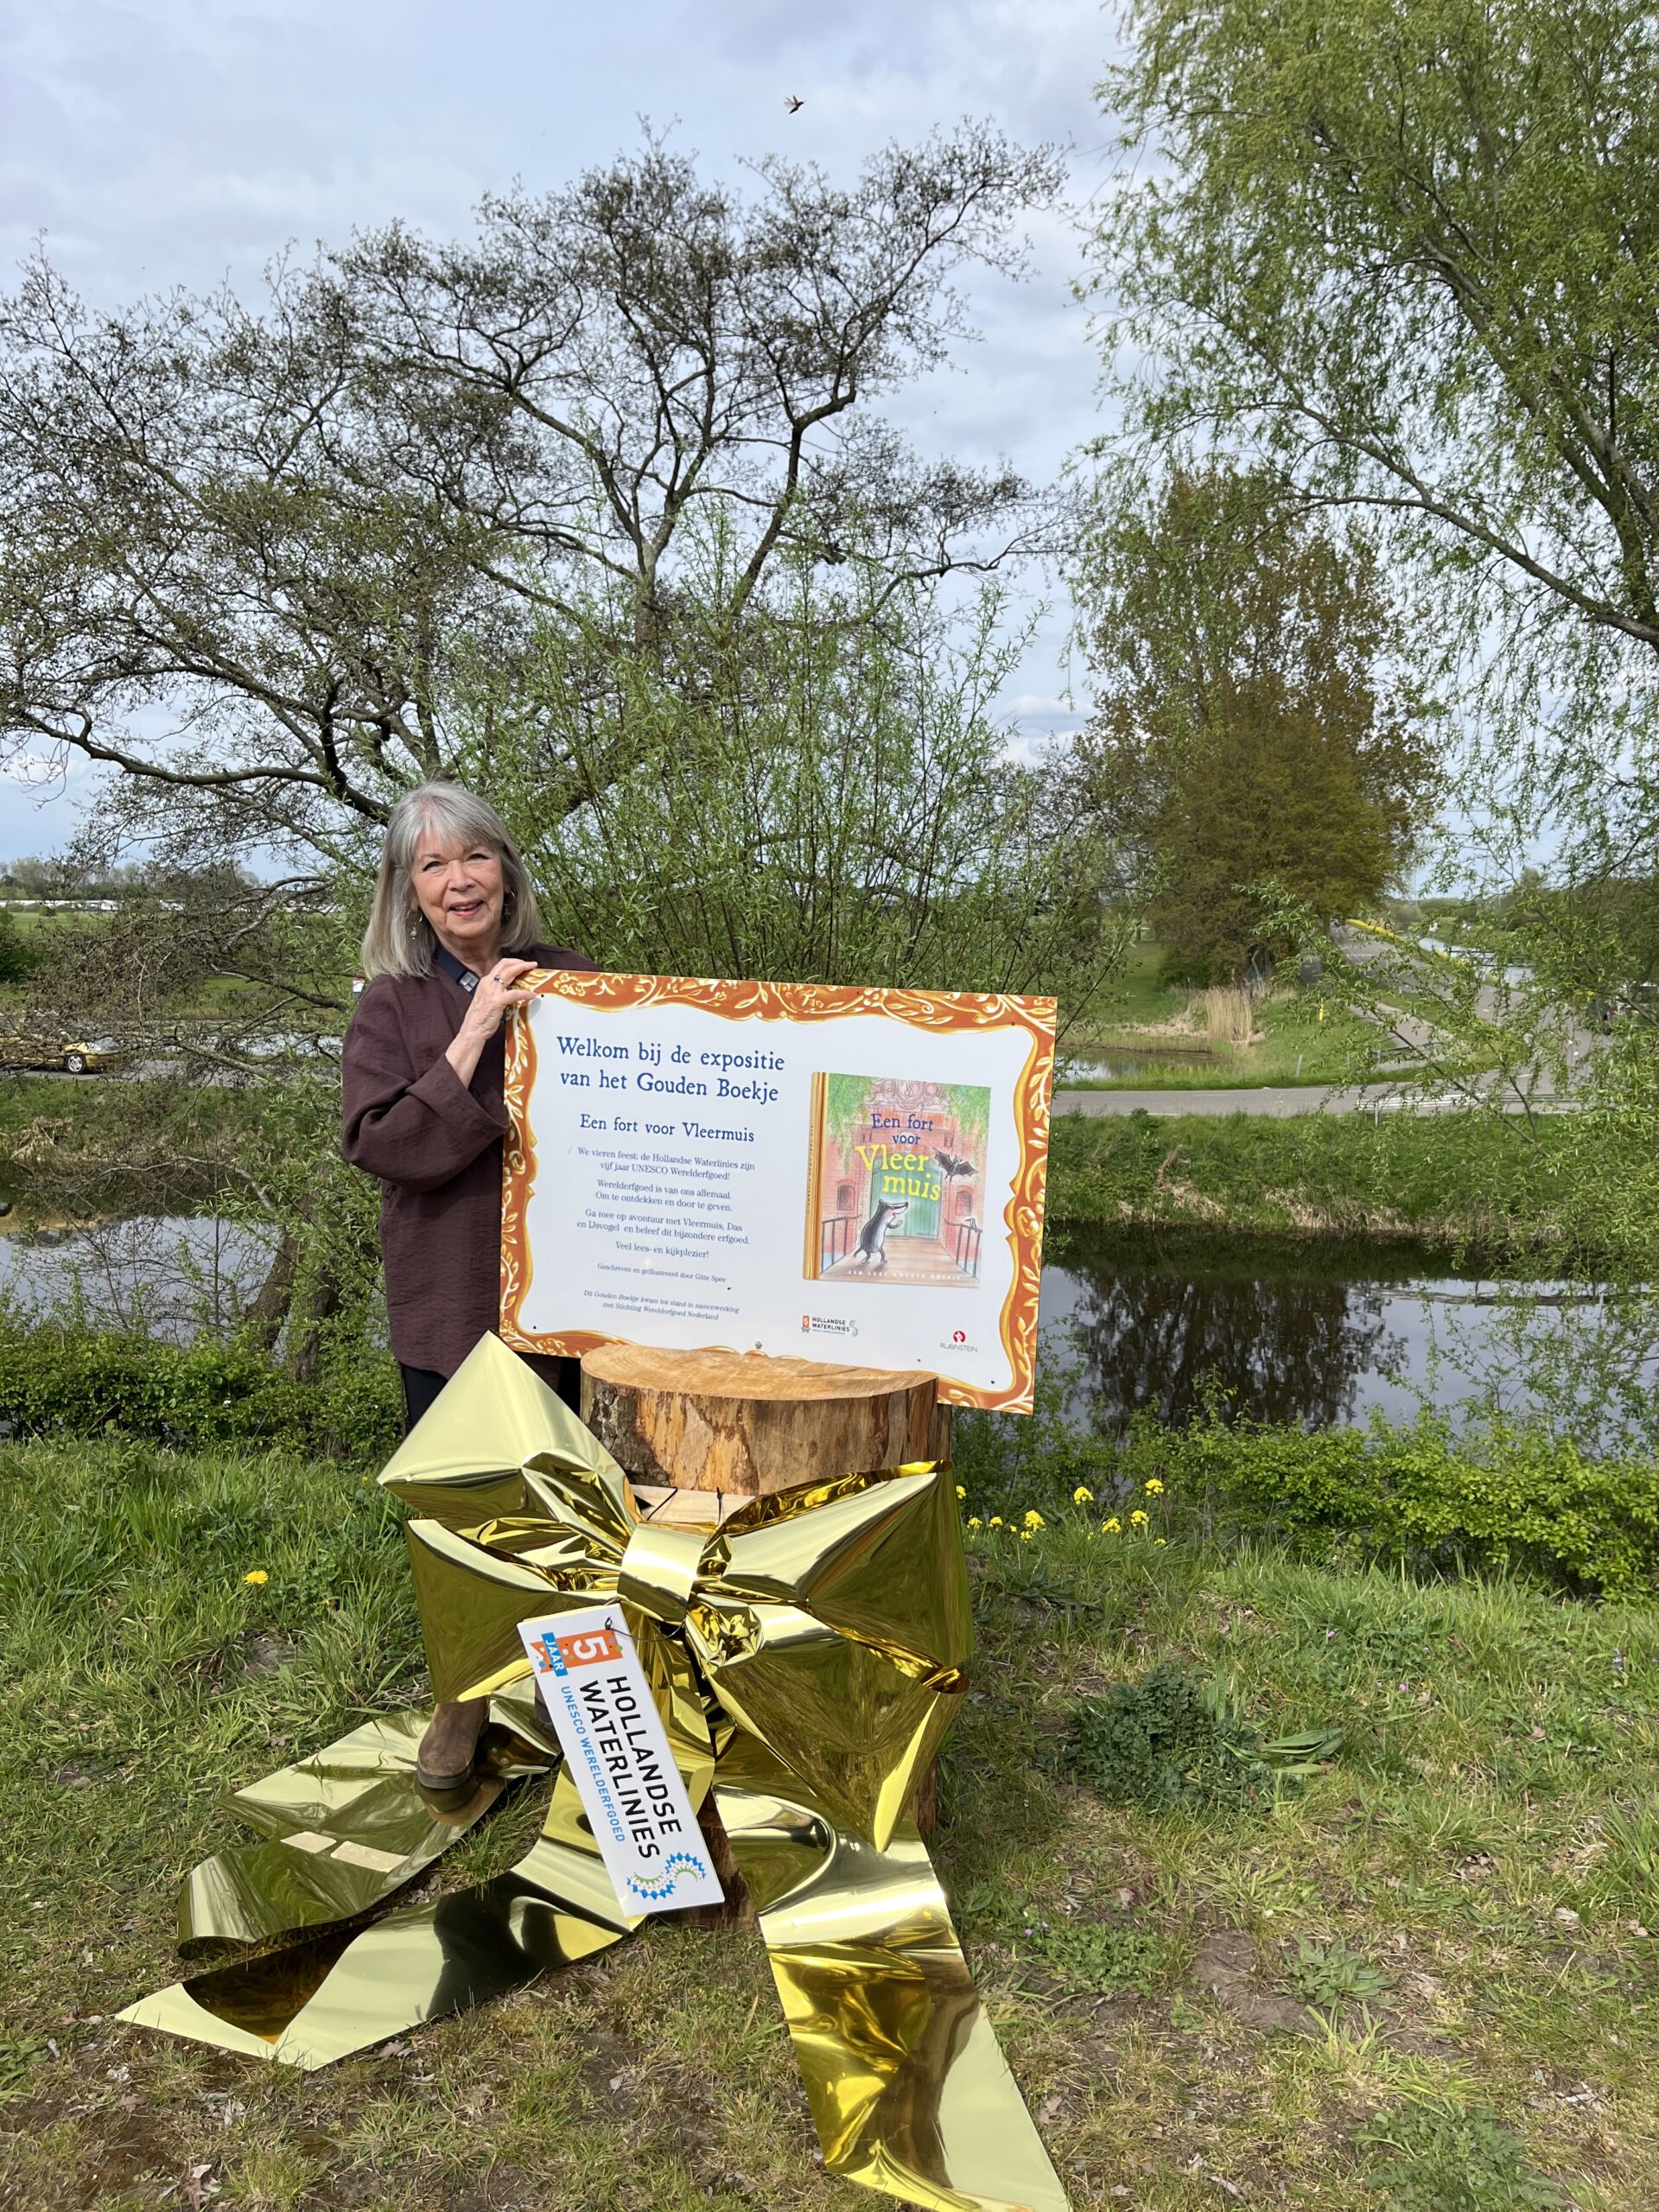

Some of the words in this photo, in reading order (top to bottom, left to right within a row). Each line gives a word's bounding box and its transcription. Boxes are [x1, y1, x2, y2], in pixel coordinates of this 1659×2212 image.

[557, 1037, 628, 1058] Welkom
[639, 1042, 661, 1065] bij
[671, 1046, 691, 1064] de
[700, 1051, 785, 1071] expositie
[561, 1072, 590, 1086] van
[599, 1070, 626, 1089] het
[637, 1072, 707, 1096] Gouden
[716, 1078, 779, 1104] Boekje
[580, 1114, 607, 1129] Een
[613, 1117, 638, 1132] fort
[645, 1123, 675, 1135] voor
[683, 1122, 753, 1142] Vleermuis
[871, 1113, 900, 1128] Een
[907, 1114, 933, 1131] fort
[893, 1135, 921, 1144] voor
[592, 1149, 615, 1158] vieren
[618, 1151, 639, 1160] feest:
[652, 1154, 691, 1165] Hollandse
[695, 1157, 738, 1169] Waterlinies
[741, 1162, 755, 1171] zijn
[855, 1144, 930, 1172] Vleer
[601, 1162, 613, 1171] vijf
[632, 1164, 668, 1174] UNESCO
[671, 1167, 730, 1180] Werelderfgoed!
[597, 1179, 653, 1192] Werelderfgoed
[696, 1189, 732, 1199] allemaal.
[883, 1173, 942, 1201] muis
[621, 1194, 663, 1205] ontdekken
[677, 1198, 696, 1208] door
[708, 1203, 733, 1211] geven.
[617, 1213, 626, 1222] op
[629, 1214, 664, 1224] avontuur
[683, 1218, 725, 1230] Vleermuis,
[727, 1223, 742, 1231] Das
[636, 1226, 659, 1236] beleef
[674, 1230, 715, 1241] bijzondere
[717, 1235, 750, 1244] erfgoed.
[616, 1242, 632, 1250] Veel
[633, 1243, 652, 1252] lees-
[665, 1248, 709, 1258] kijkplezier!
[812, 1323, 849, 1332] WATERLINIES
[940, 1343, 977, 1352] RUBINSTEIN
[545, 1640, 565, 1672] JAAR
[573, 1637, 609, 1660] 5
[561, 1686, 586, 1733] UNESCO
[581, 1738, 626, 1842] WERELDERFGOED
[607, 1675, 682, 1834] HOLLANDSE
[579, 1680, 660, 1859] WATERLINIES
